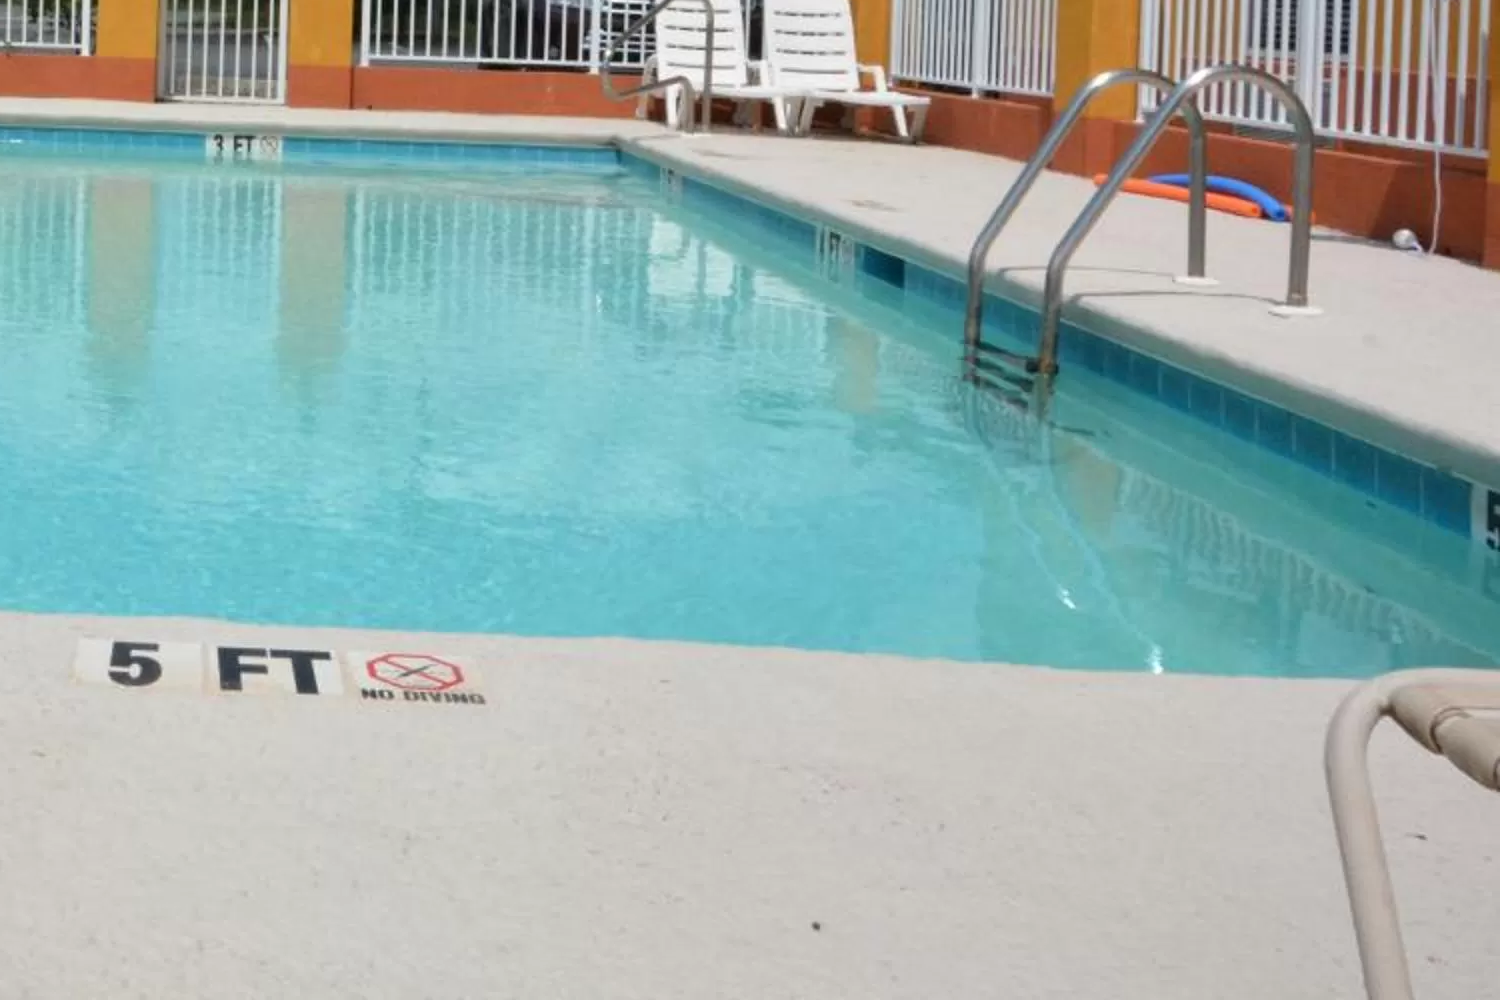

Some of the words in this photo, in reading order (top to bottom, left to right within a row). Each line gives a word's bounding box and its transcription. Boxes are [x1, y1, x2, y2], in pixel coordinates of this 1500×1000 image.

[233, 134, 257, 153] FT
[108, 640, 163, 686] 5
[217, 645, 332, 695] FT
[361, 688, 395, 701] NO
[402, 690, 486, 704] DIVING
